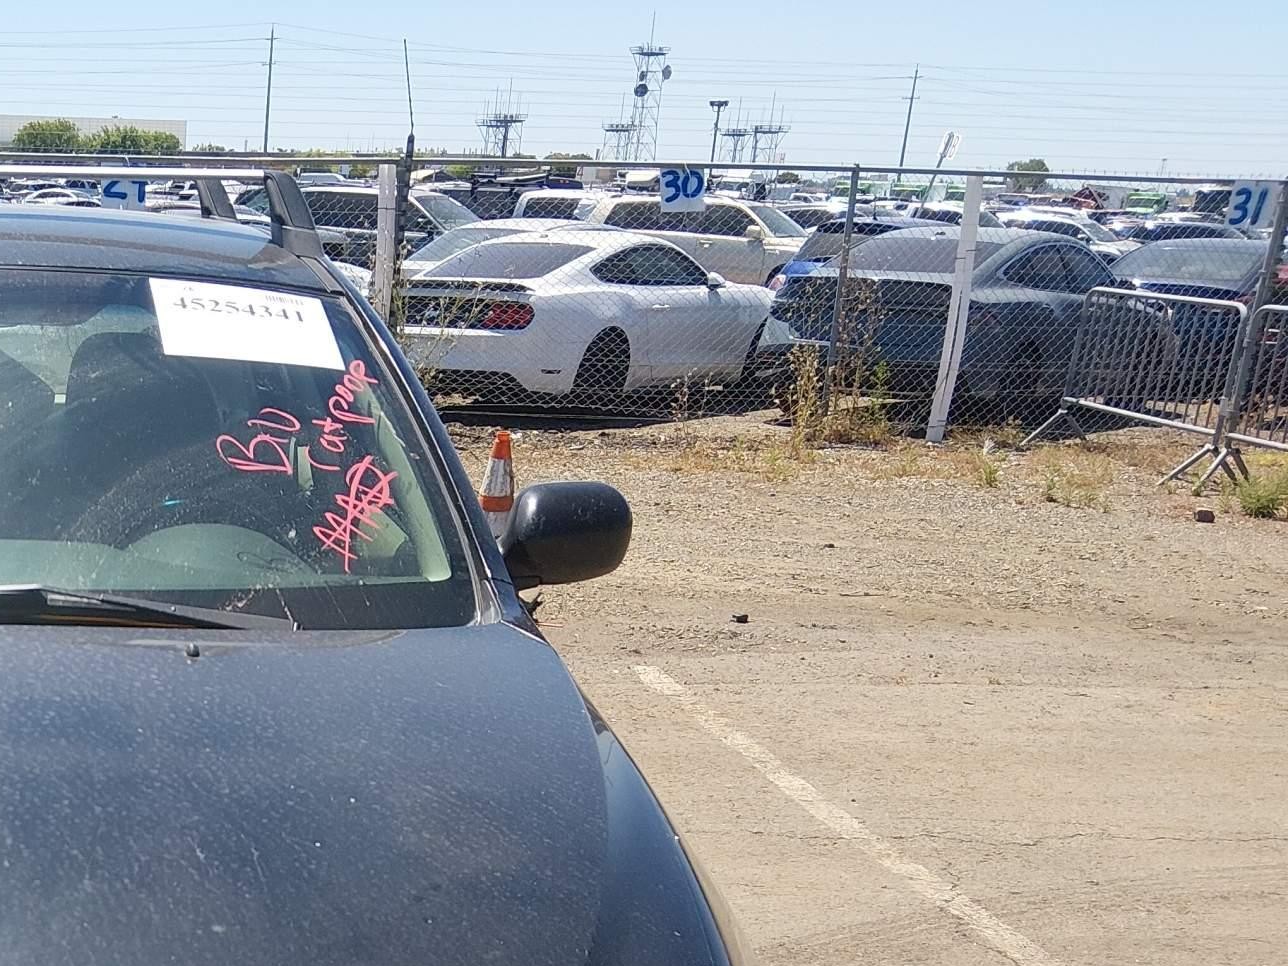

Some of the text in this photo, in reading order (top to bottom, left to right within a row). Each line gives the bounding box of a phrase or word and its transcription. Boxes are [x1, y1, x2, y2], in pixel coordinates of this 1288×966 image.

[661, 170, 704, 203] 30
[1228, 187, 1268, 226] 31
[173, 297, 304, 323] 45254341
